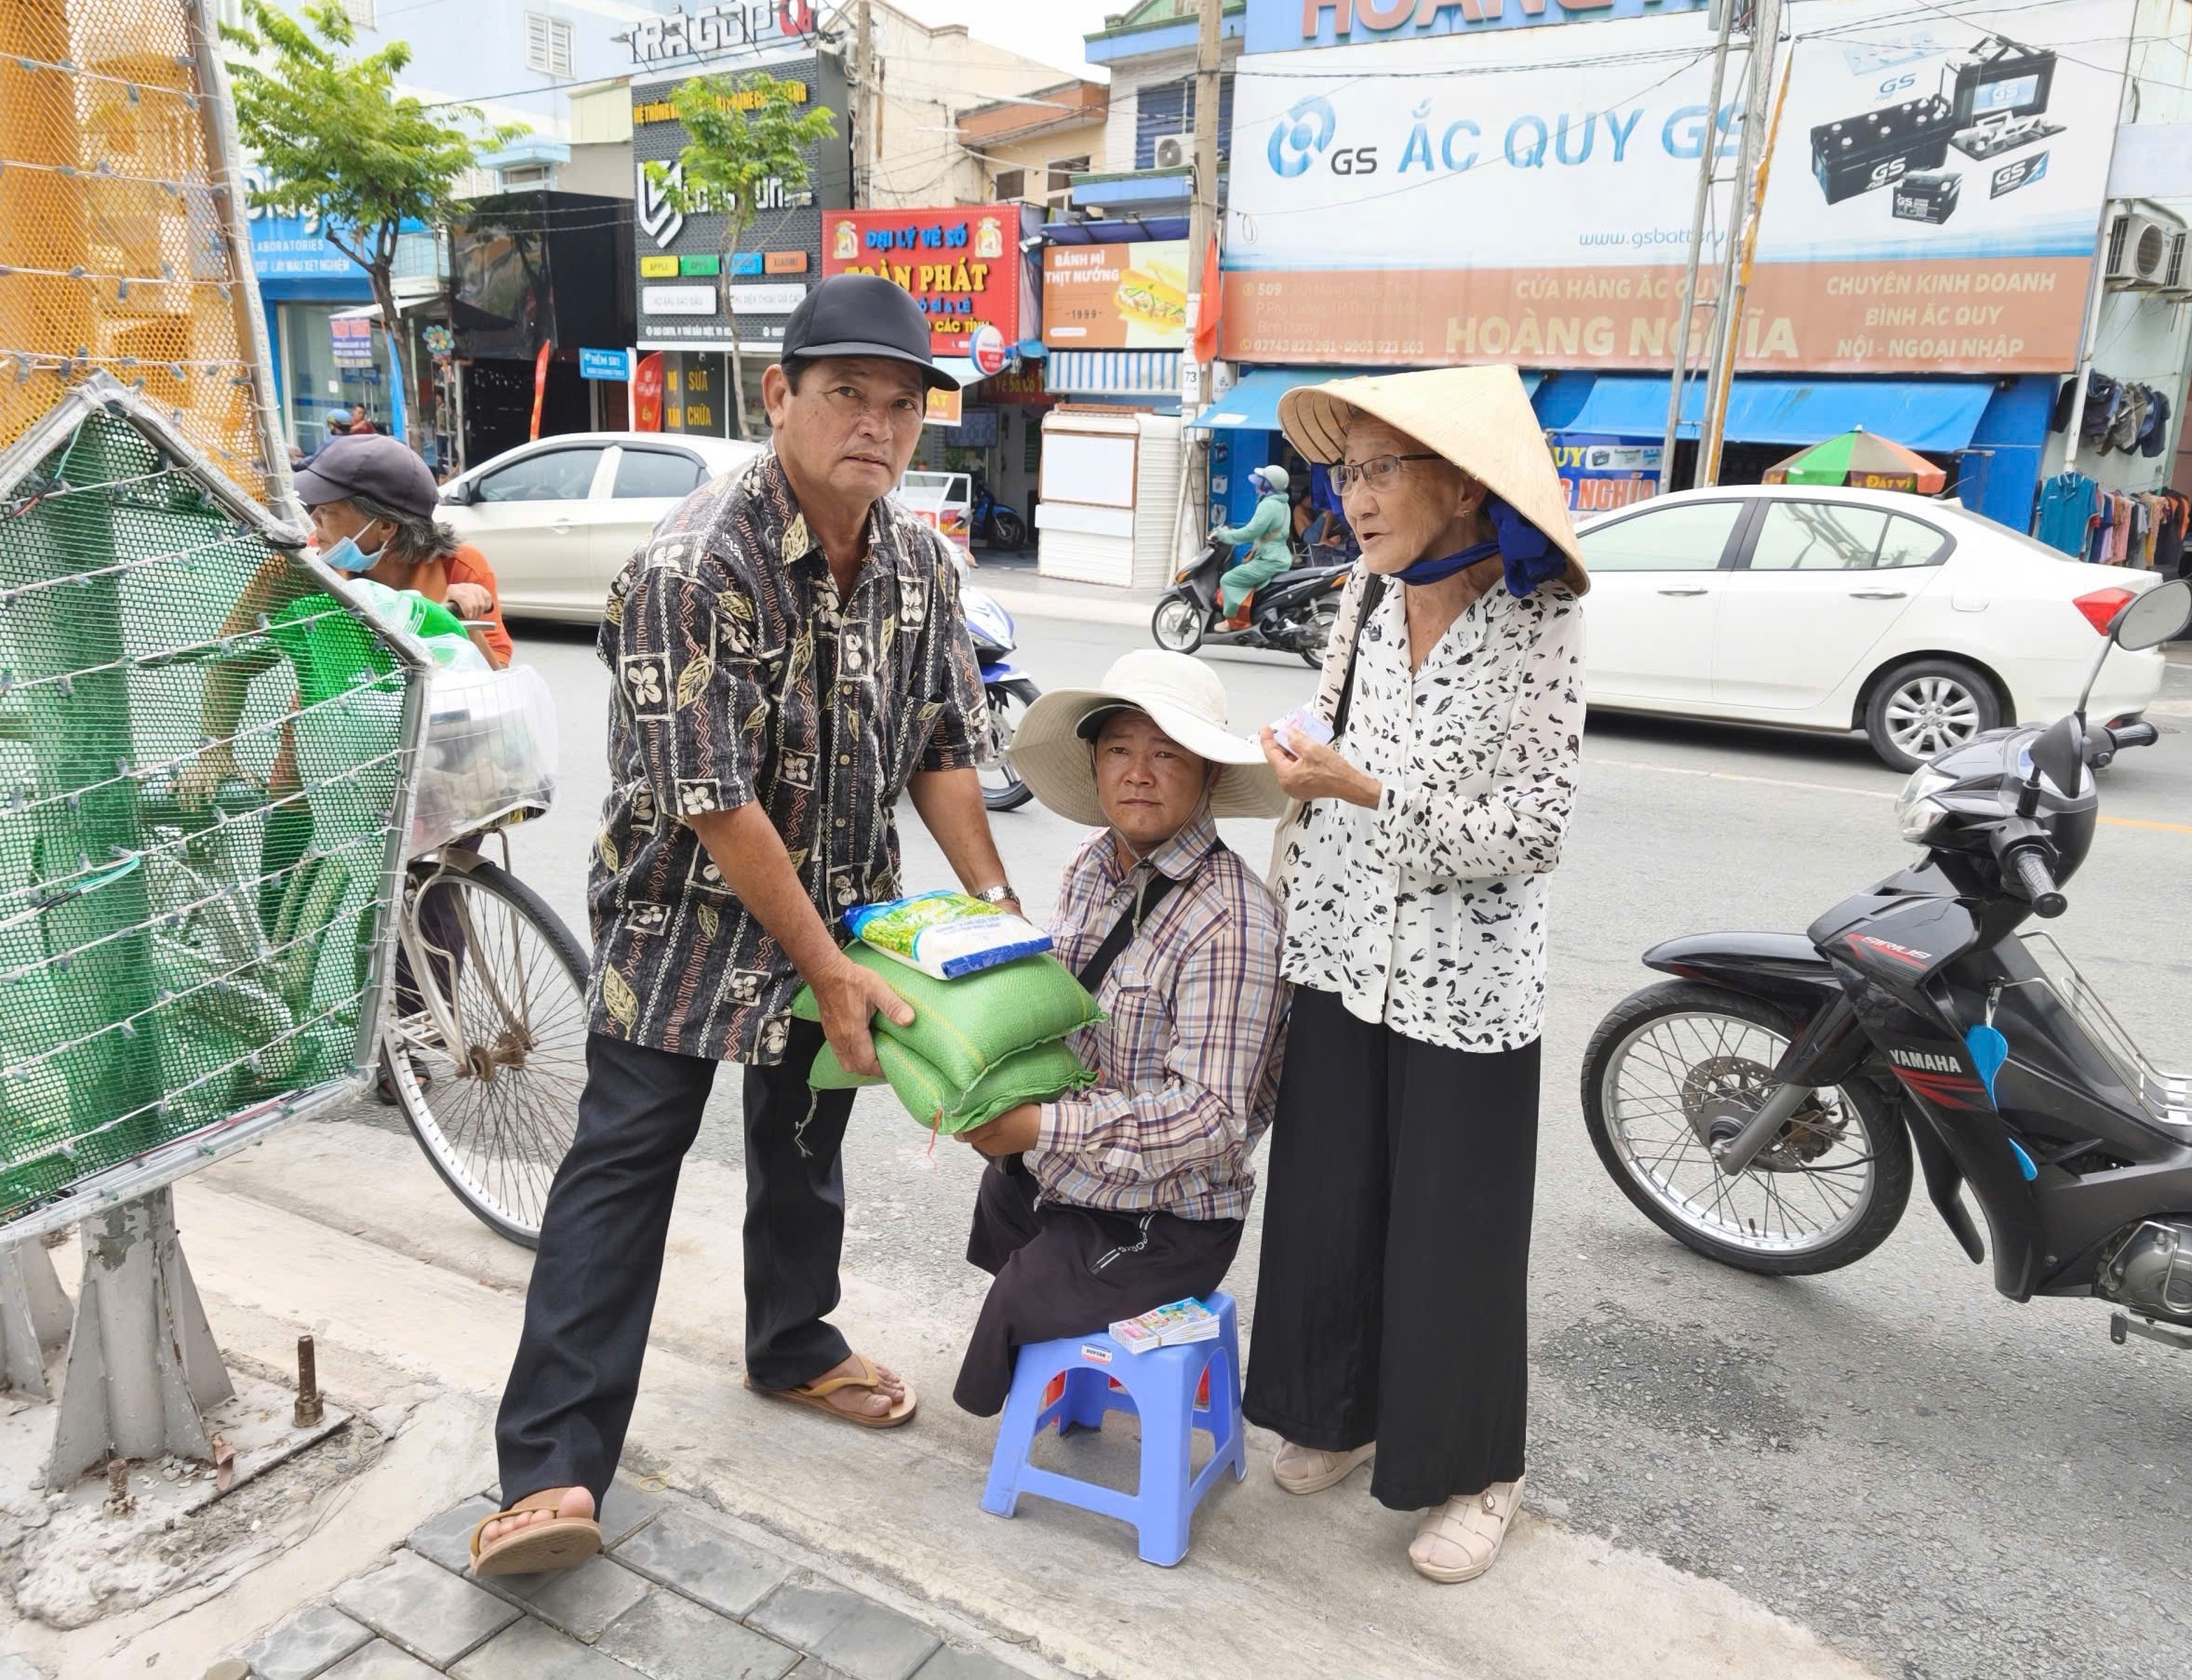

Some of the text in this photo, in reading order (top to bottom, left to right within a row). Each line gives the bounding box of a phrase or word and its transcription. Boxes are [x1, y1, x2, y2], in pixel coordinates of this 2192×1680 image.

[1879, 73, 1917, 94] GS
[1993, 83, 2018, 101] GS
[1331, 147, 1378, 176] GS
[1397, 97, 1481, 173] ẮC
[1504, 109, 1644, 169] QUY
[1871, 156, 1906, 181] GS
[1995, 161, 2026, 185] GS
[866, 222, 969, 251] ĐẠI LÝ VÉ SỐ
[1055, 249, 1105, 267] BÁNH MÌ
[919, 257, 989, 292] PHÁT
[1045, 268, 1120, 287] THỊT NƯỚNG
[1516, 273, 1562, 300] CỬA
[1566, 273, 1631, 300] HÀNG
[1637, 269, 1667, 300] ẮC
[1826, 272, 2056, 295] CHUYÊN KINH DOANH
[1258, 282, 1283, 297] 509
[1865, 296, 2003, 327] BÌNH ẮC QUY
[934, 317, 962, 333] CÁC
[1446, 308, 1799, 359] HOÀNG NGĨA
[1837, 335, 1873, 360] NỘI
[1889, 337, 1955, 360] NGOẠI
[1958, 335, 2024, 359] NHẬP
[1185, 372, 1197, 383] 73
[1553, 447, 1586, 467] UY
[1861, 936, 1931, 960] SIRIUS
[1890, 1048, 1962, 1073] YAMAHA
